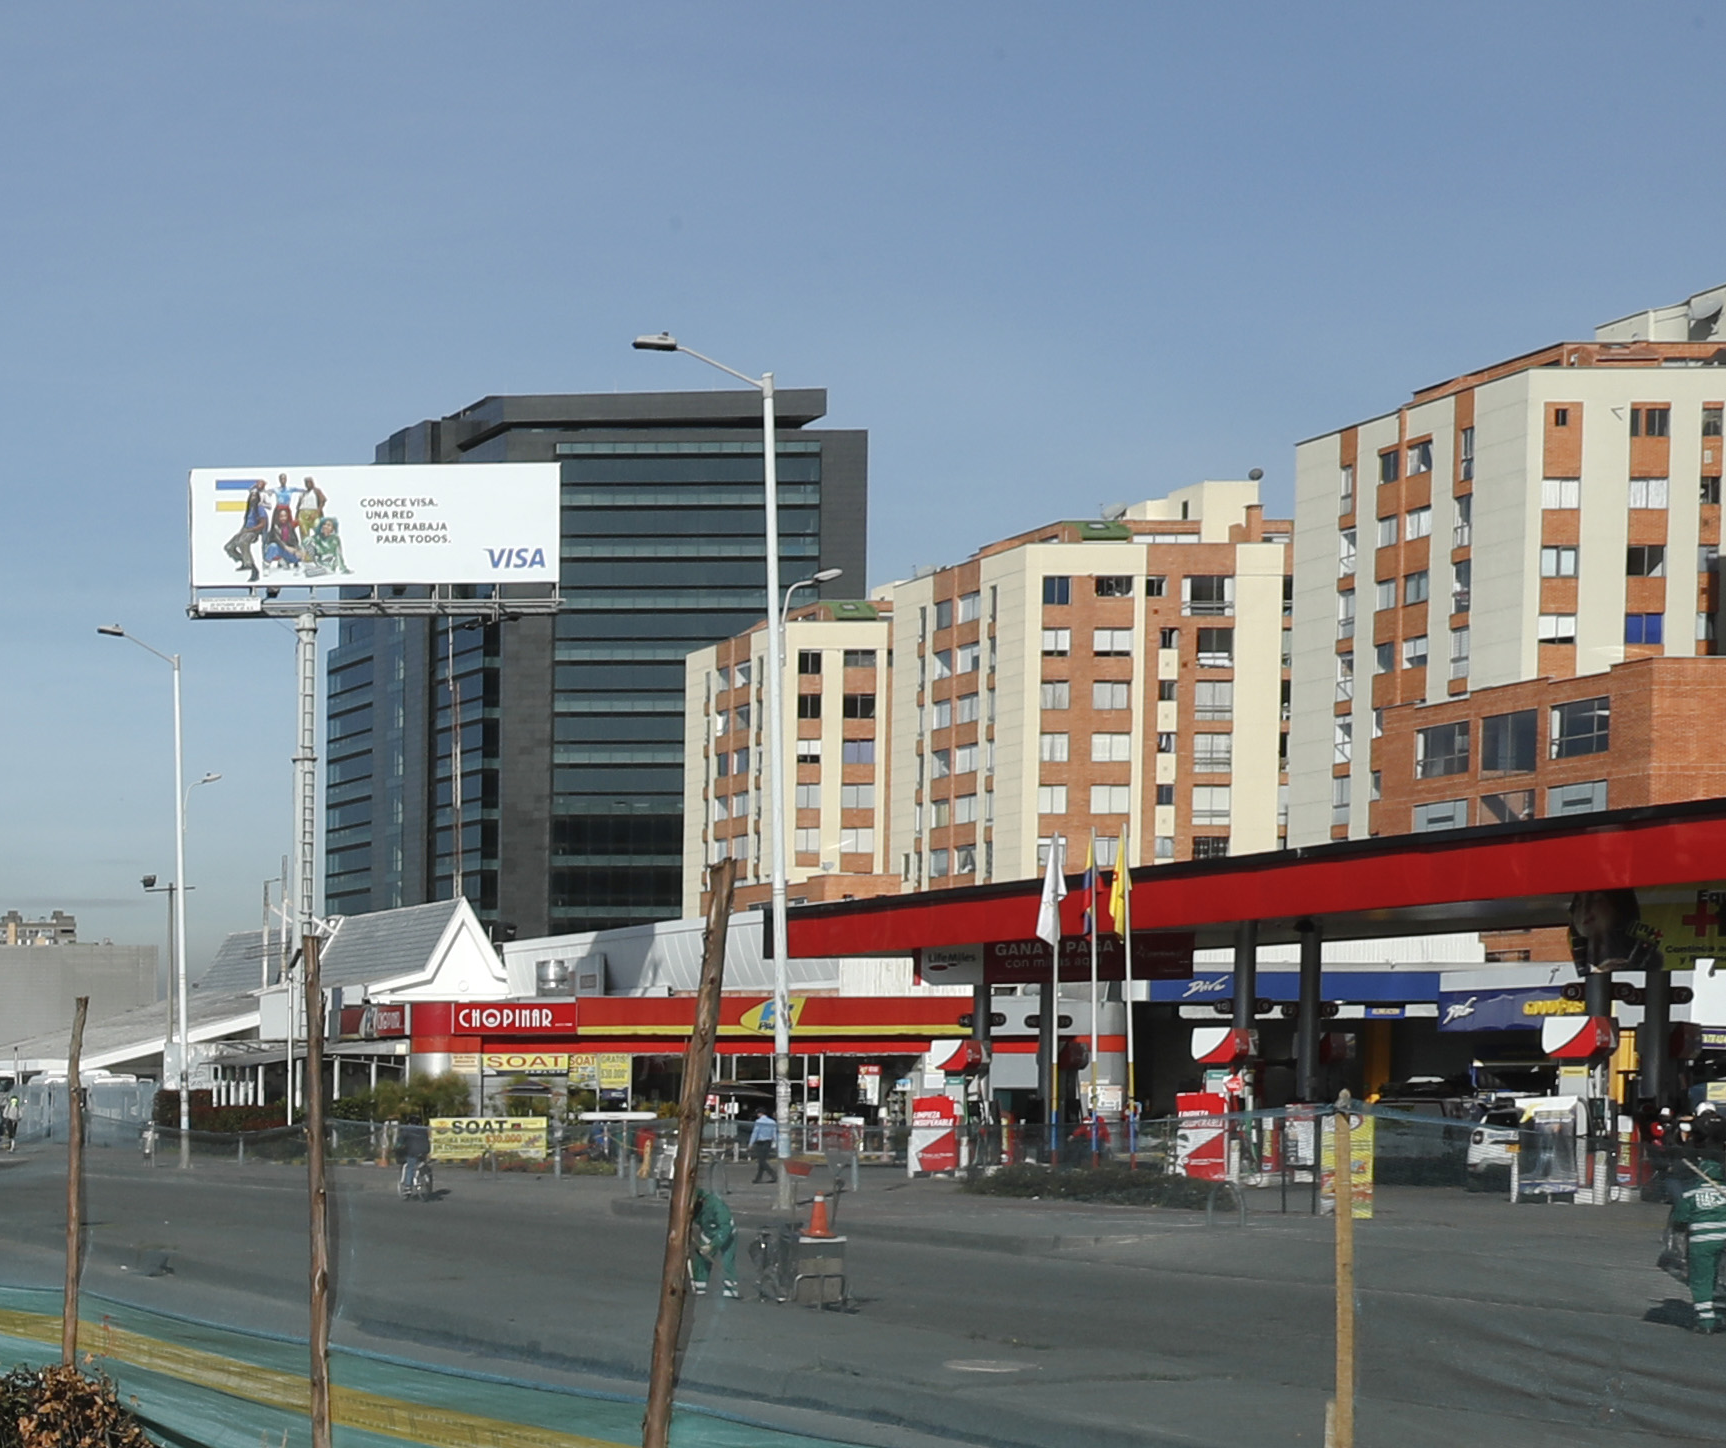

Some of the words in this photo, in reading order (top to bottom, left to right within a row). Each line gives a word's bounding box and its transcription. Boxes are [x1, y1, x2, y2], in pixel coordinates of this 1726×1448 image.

[360, 498, 407, 507] CONOCE
[409, 498, 438, 507] VISA.
[366, 510, 389, 519] UNA
[392, 510, 414, 519] RED
[371, 523, 394, 532] QUE
[396, 522, 447, 531] TRABAJA
[376, 535, 406, 544] PARA
[408, 535, 451, 544] TODOS.
[483, 548, 546, 569] VISA
[995, 943, 1043, 956] GANA
[928, 951, 976, 963] LifeMiles
[458, 1008, 552, 1028] CHOPINAR
[487, 1055, 563, 1068] SOAT
[570, 1055, 595, 1066] SOAT
[451, 1120, 507, 1135] SOAT
